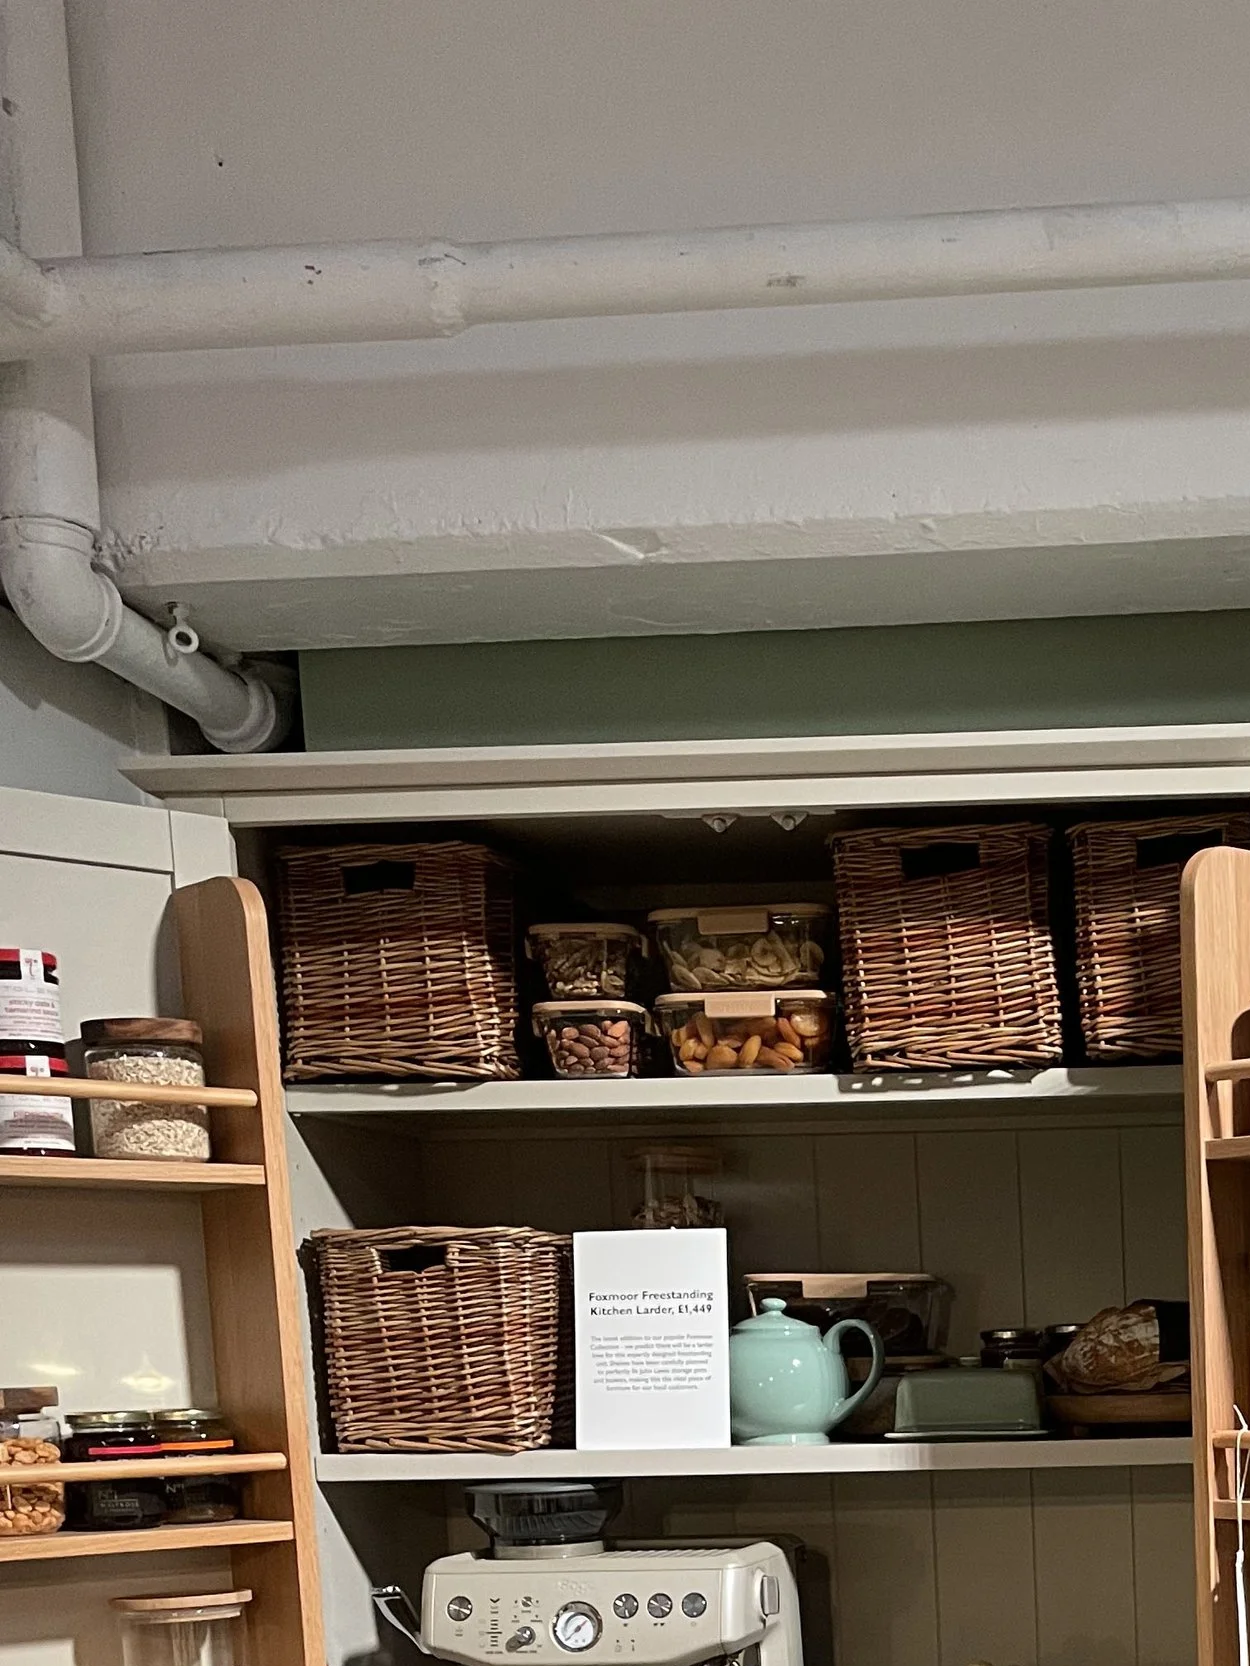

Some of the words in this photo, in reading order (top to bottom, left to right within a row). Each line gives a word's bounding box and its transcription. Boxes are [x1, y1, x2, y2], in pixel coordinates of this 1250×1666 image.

[589, 1291, 639, 1302] Foxmoor
[642, 1290, 714, 1301] Freestanding
[590, 1305, 633, 1316] Kitchen
[636, 1305, 674, 1316] Larder,
[678, 1304, 712, 1315] £1,449
